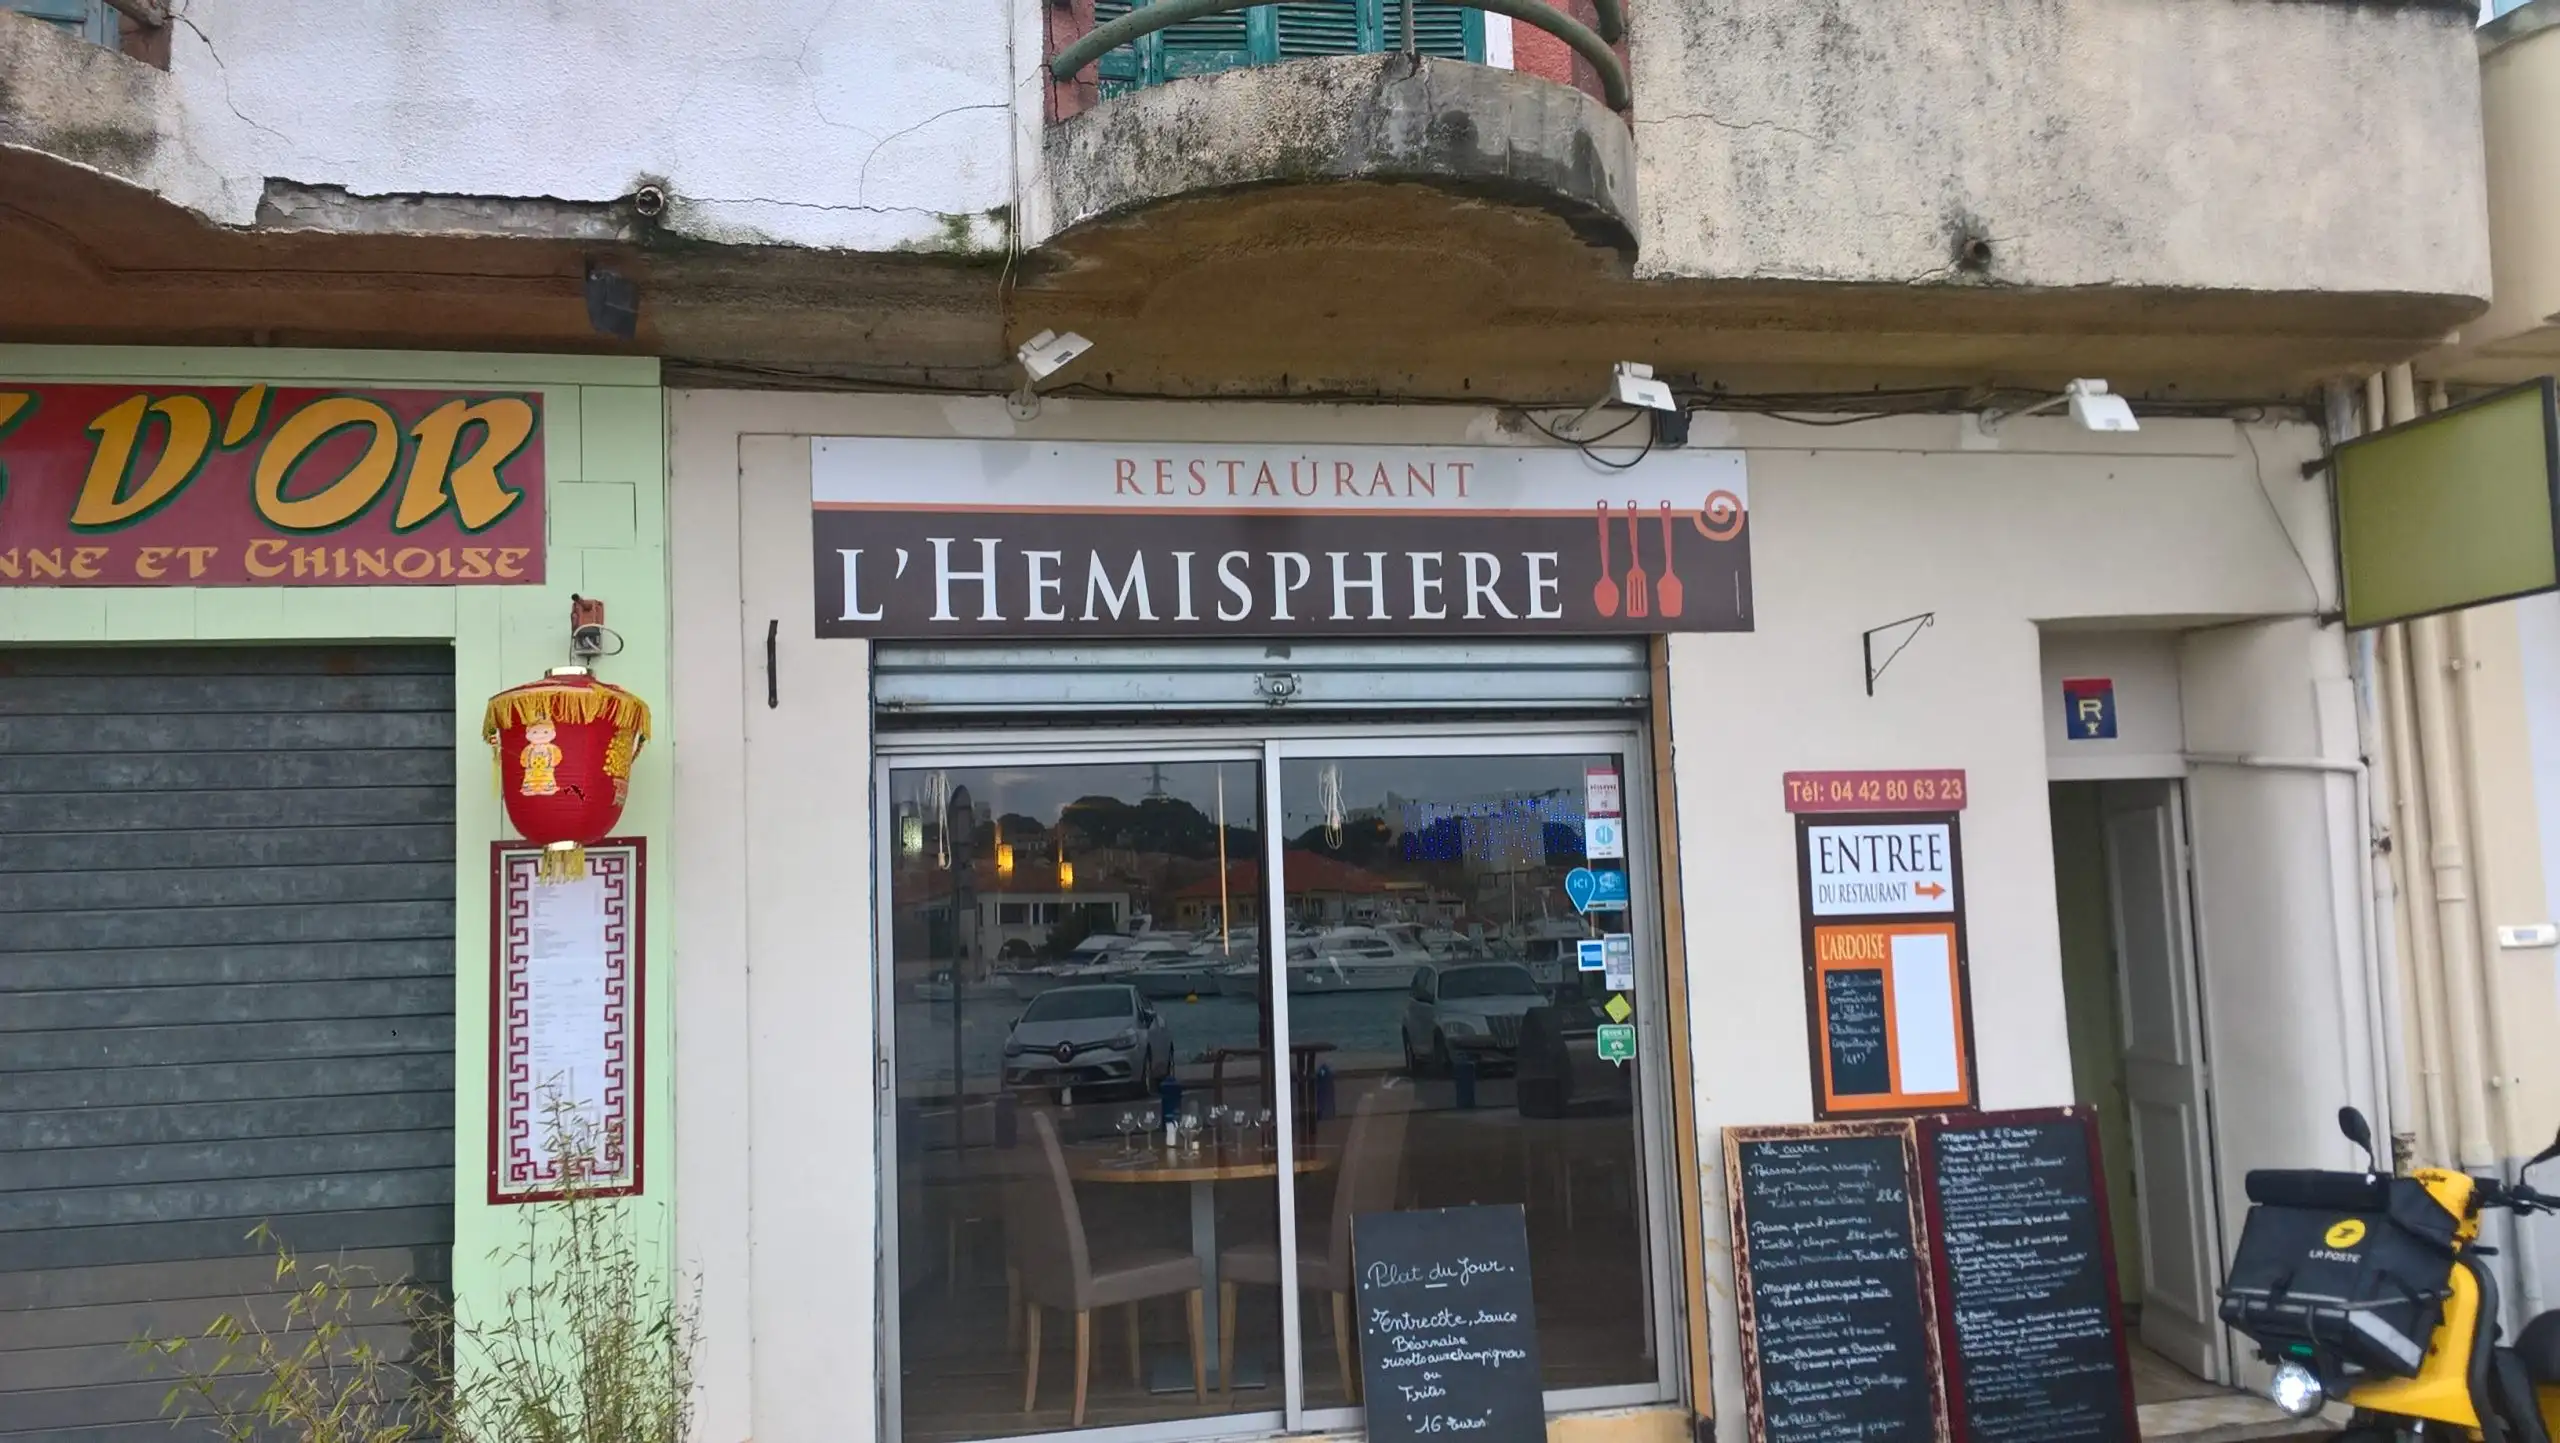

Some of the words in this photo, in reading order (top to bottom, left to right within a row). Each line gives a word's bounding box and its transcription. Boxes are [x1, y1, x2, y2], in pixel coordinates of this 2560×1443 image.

[70, 383, 538, 532] D'OR
[1115, 458, 1476, 499] RESTAURANT
[135, 546, 219, 579] ET
[837, 537, 1564, 624] L'HEMISPHERE
[1789, 780, 1825, 802] Tél:
[1831, 780, 1853, 802] 04
[1858, 780, 1880, 802] 42
[1886, 779, 1908, 801] 80
[1913, 778, 1935, 800] 63
[1941, 778, 1963, 800] 23
[1818, 832, 1943, 874] ENTREE
[1573, 878, 1588, 889] ICI
[1819, 883, 1836, 903] DU
[1838, 881, 1909, 903] RESTAURANT
[1821, 933, 1885, 961] L'ARDOISE
[2308, 1249, 2324, 1260] LA
[2324, 1250, 2362, 1265] POSTE
[1368, 1261, 1424, 1289] Plat
[1429, 1262, 1457, 1280] du
[1458, 1257, 1505, 1286] Jour
[1423, 1371, 1443, 1381] ou
[1398, 1384, 1446, 1403] Frites
